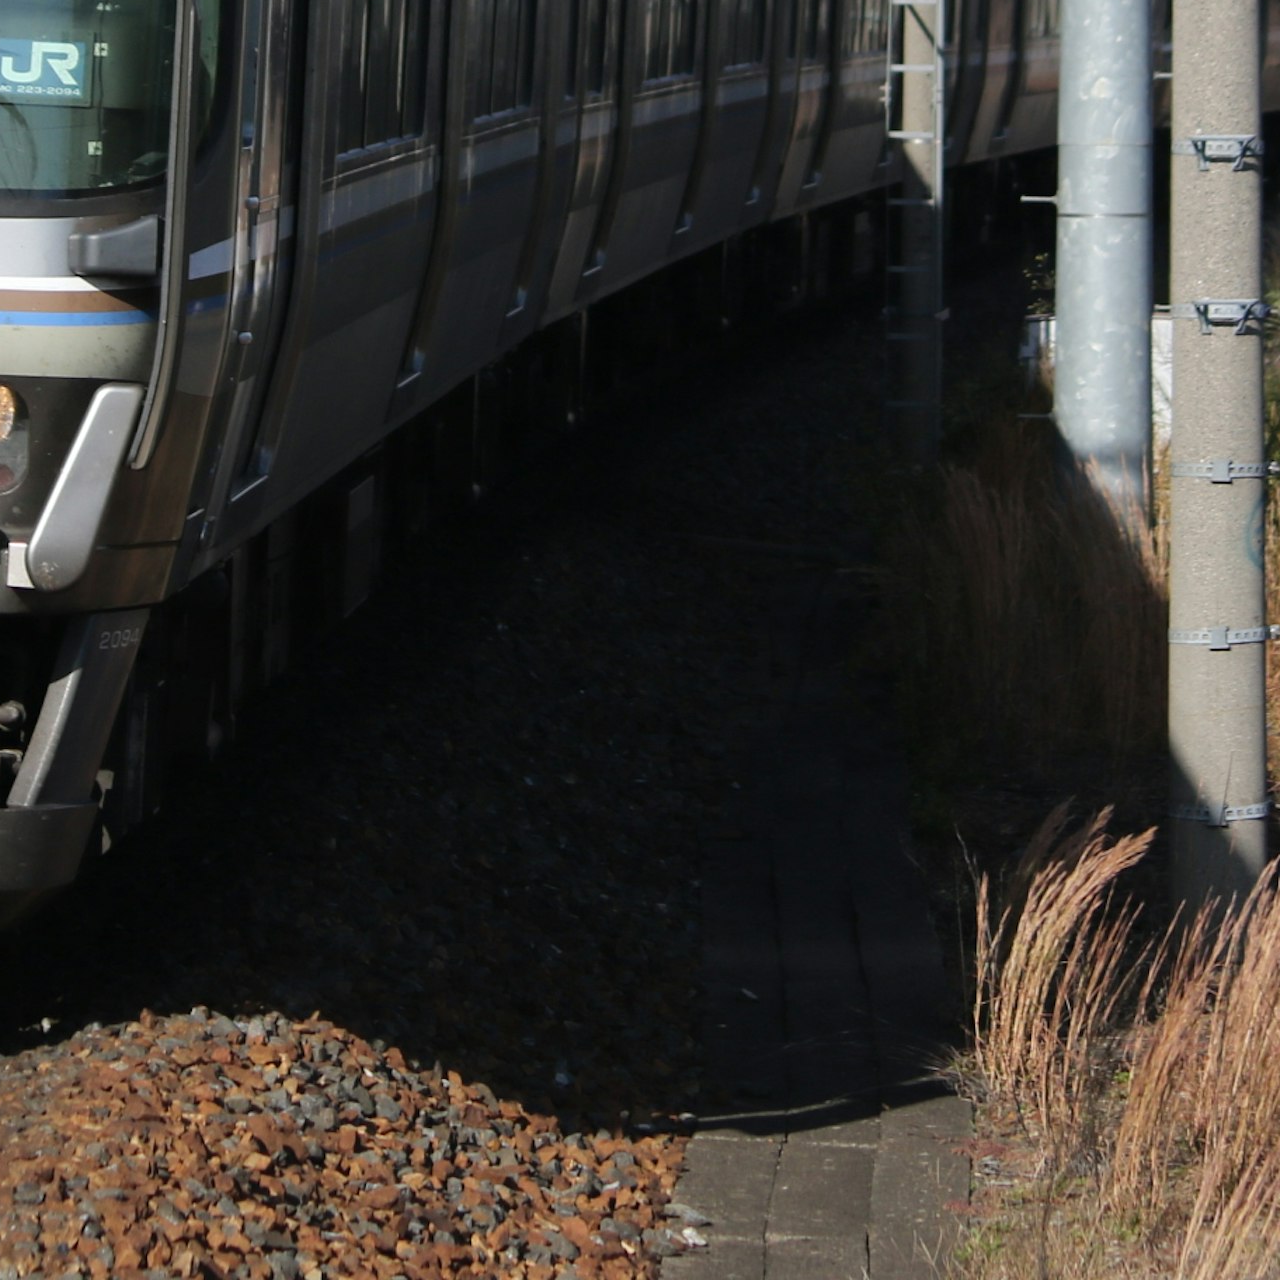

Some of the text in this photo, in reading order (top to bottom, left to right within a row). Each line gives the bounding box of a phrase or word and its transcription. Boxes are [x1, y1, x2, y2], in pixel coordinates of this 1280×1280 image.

[0, 40, 80, 85] JR
[16, 85, 80, 97] 223-2094
[99, 627, 140, 650] 2094
